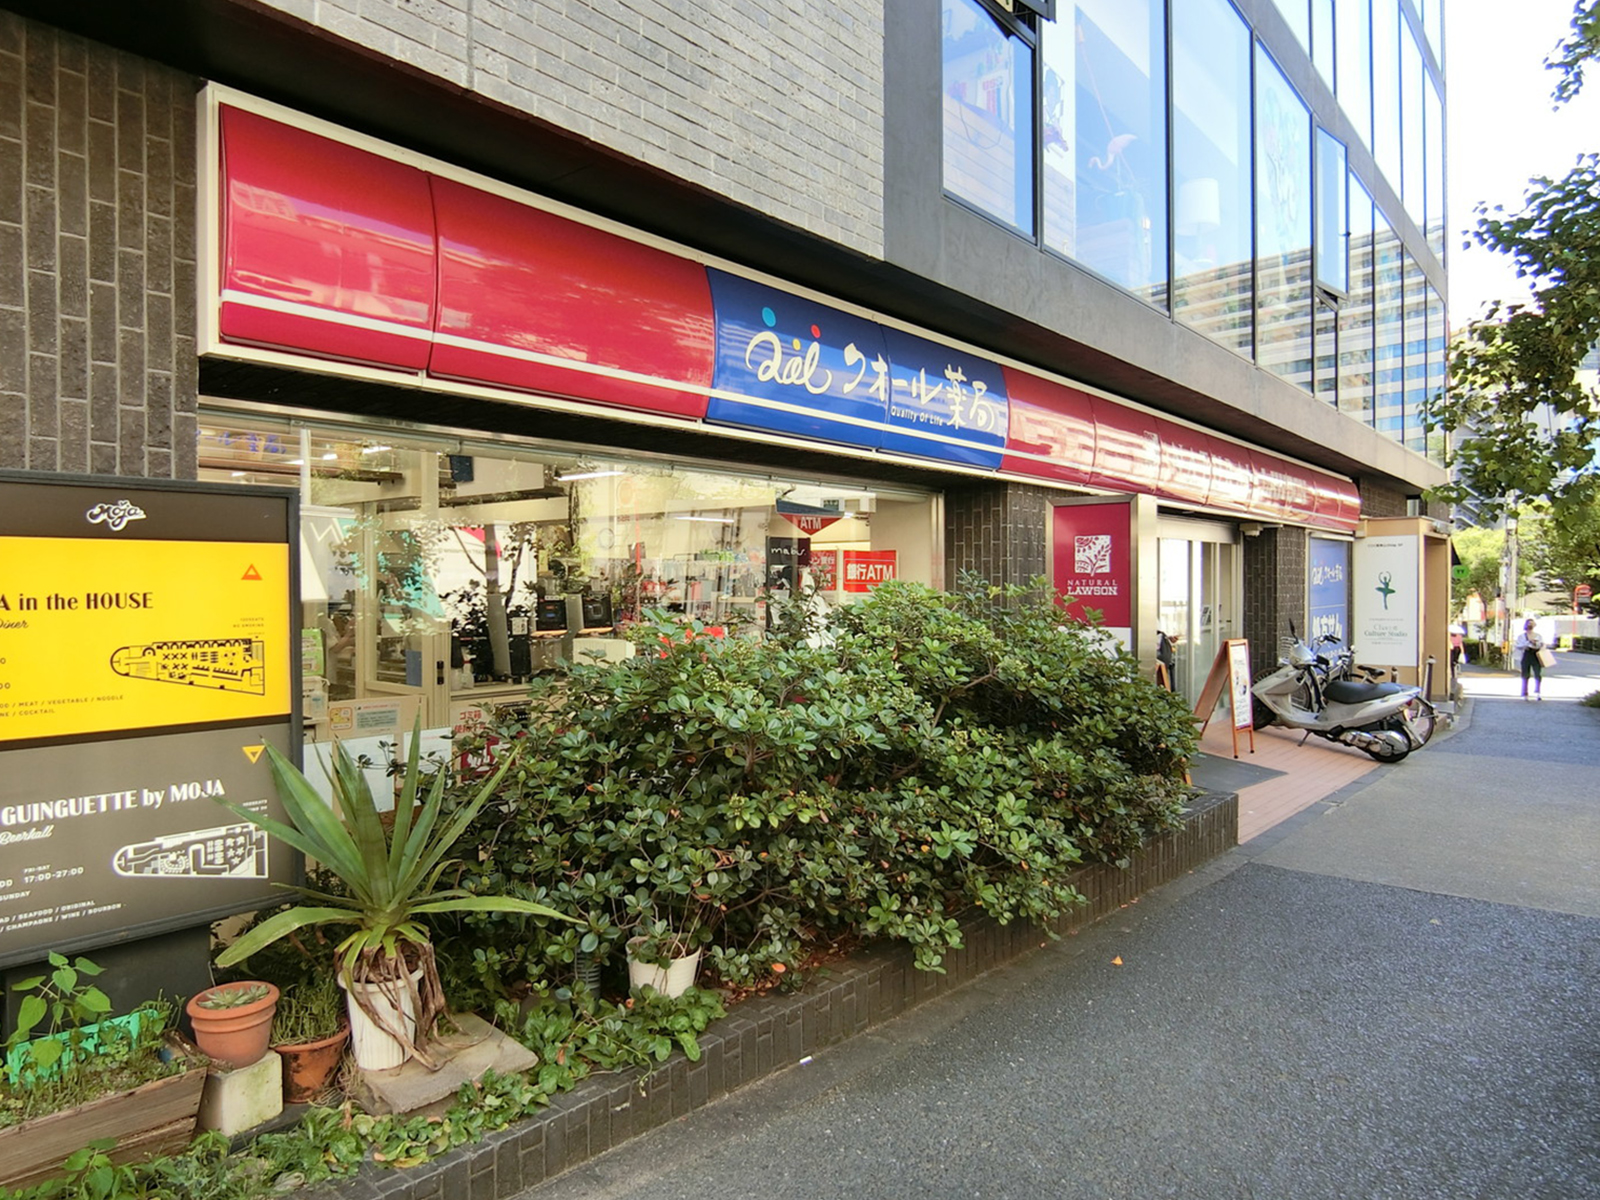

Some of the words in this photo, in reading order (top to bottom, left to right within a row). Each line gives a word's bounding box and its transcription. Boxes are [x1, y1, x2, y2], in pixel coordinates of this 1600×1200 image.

[843, 342, 996, 432] クオール薬局
[890, 405, 918, 423] Quality
[800, 516, 822, 530] ATM
[846, 563, 894, 581] 銀行ATM
[1067, 579, 1119, 587] NATURAL
[1067, 586, 1119, 596] LAWSON
[19, 593, 38, 611] in
[46, 593, 79, 610] the
[86, 592, 153, 610] HOUSE
[48, 696, 88, 705] VEGETABLE
[97, 694, 124, 702] NOODLE
[19, 708, 56, 717] COCKTAIL
[1, 789, 138, 826] GUINGUETTE
[142, 788, 166, 809] by
[170, 778, 226, 803] MOJA
[0, 824, 54, 846] Beerhall
[23, 866, 84, 884] 17:00-27:00
[0, 890, 31, 902] SUNDAY
[6, 916, 54, 931] CHAMPAGNE
[61, 911, 80, 920] WINE
[87, 902, 122, 915] BOURBON
[18, 907, 54, 920] SEAFOOD
[61, 900, 96, 912] ORIGINAL
